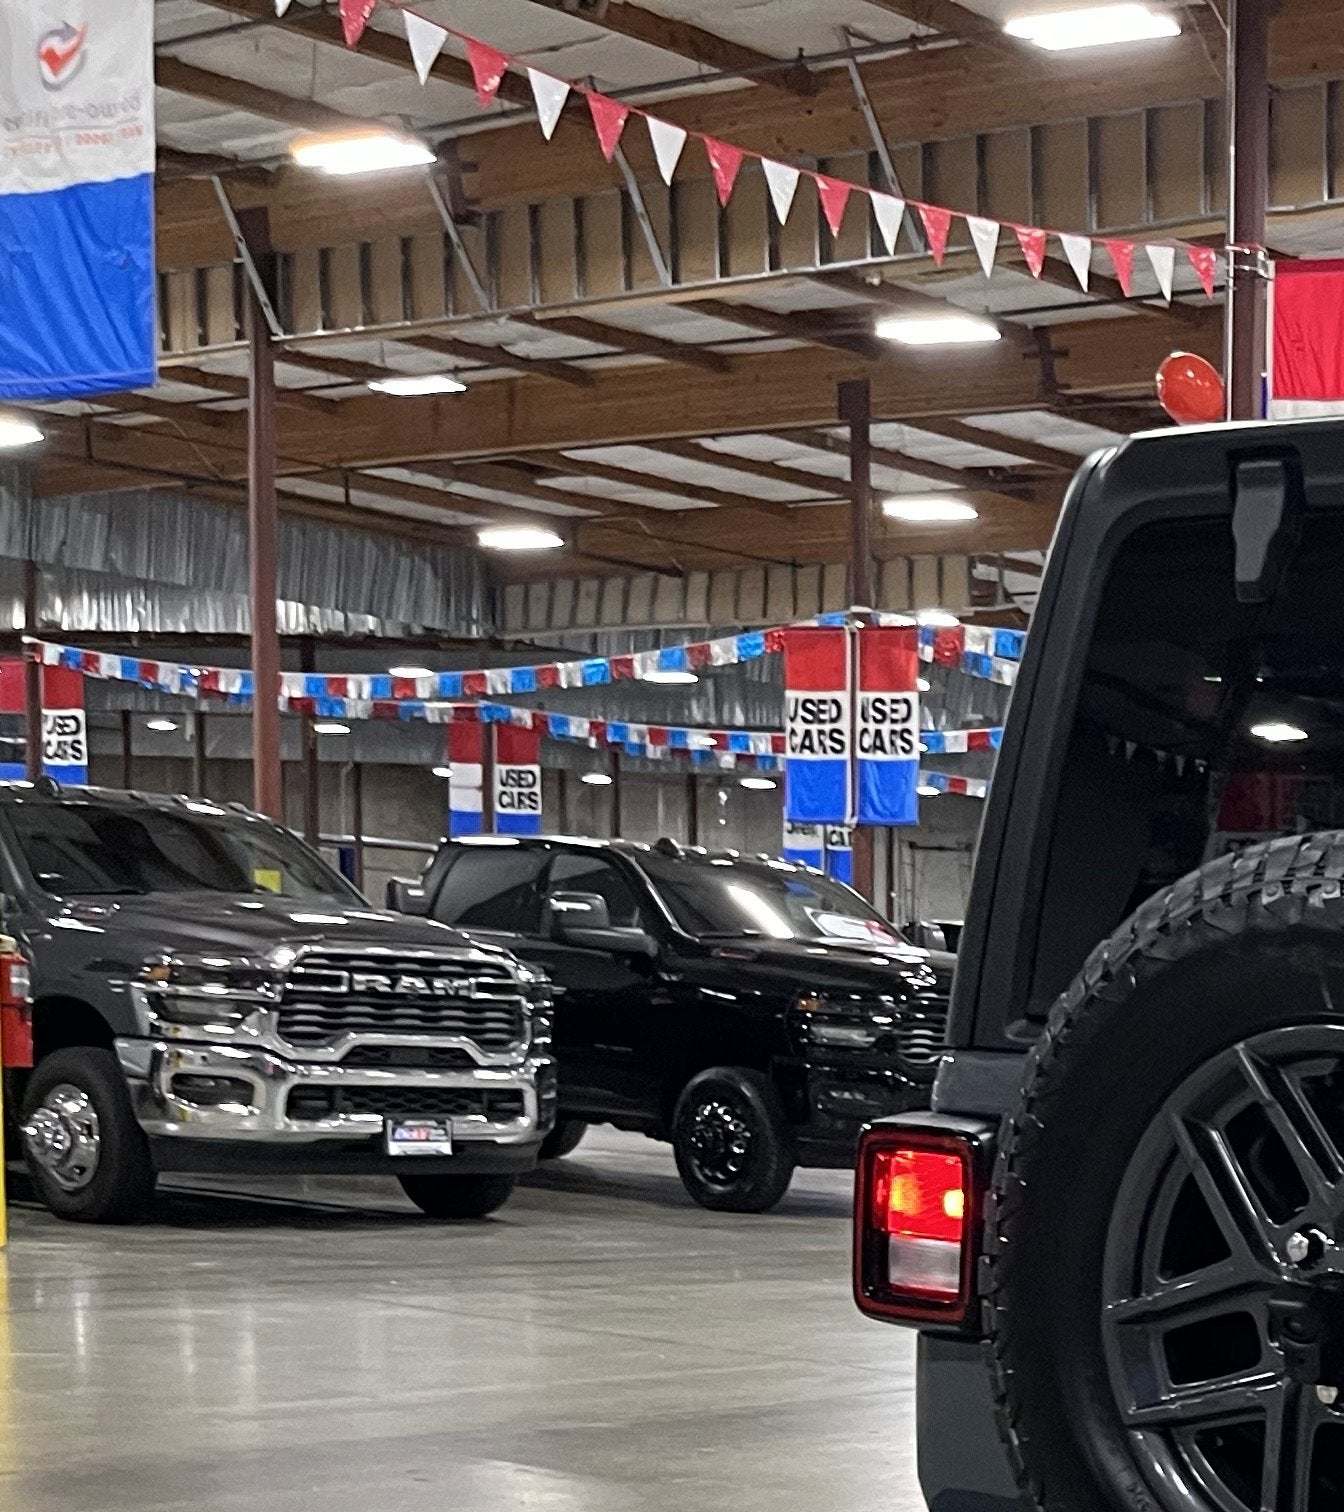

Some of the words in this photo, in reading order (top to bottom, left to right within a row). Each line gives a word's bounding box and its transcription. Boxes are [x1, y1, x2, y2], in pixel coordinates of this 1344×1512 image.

[789, 697, 842, 725] USED
[861, 697, 913, 725] USED
[44, 739, 83, 761] CS
[788, 727, 846, 755] CARS
[859, 727, 914, 755] CARS
[499, 769, 537, 788] USED
[352, 973, 470, 997] RAM
